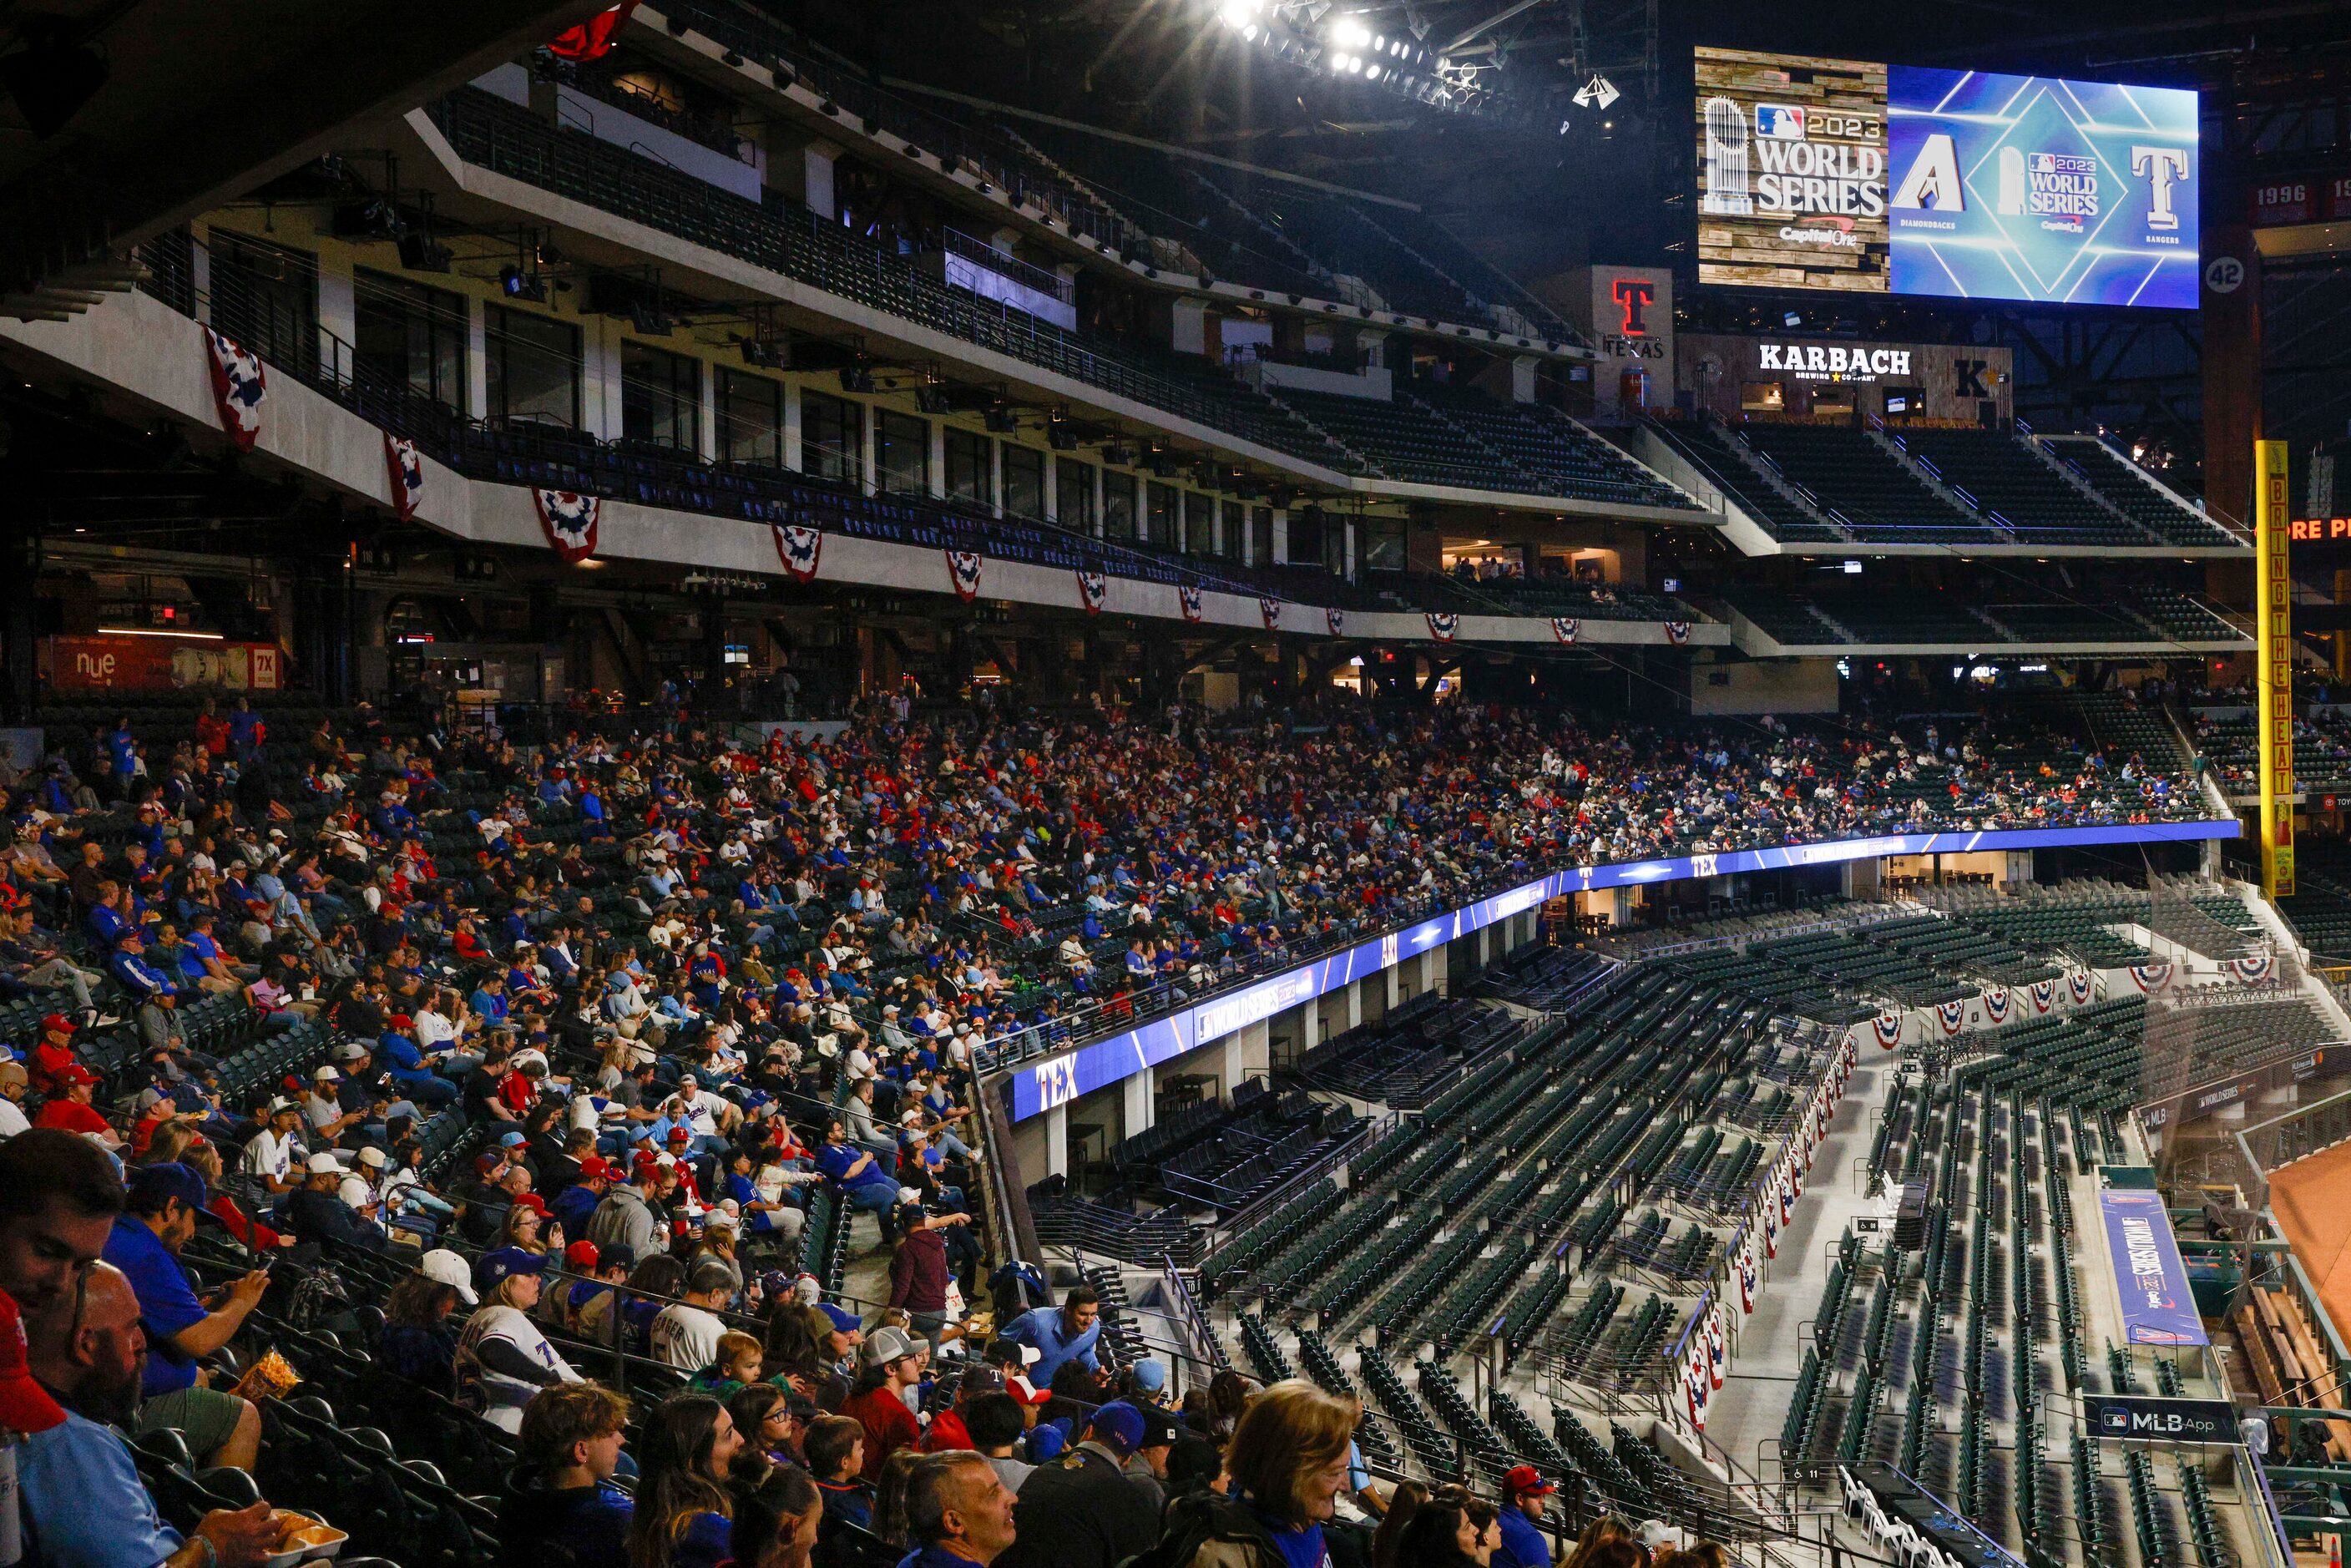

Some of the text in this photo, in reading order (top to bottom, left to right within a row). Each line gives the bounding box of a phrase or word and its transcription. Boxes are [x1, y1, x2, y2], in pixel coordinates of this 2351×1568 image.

[1807, 115, 1880, 139] 2023
[1755, 139, 1883, 180] WORLD
[2056, 158, 2096, 172] 2023
[2029, 173, 2098, 195] WORLD
[1757, 174, 1884, 217] SERIES
[2030, 192, 2099, 217] SERIES
[2257, 185, 2306, 205] 1996
[1900, 219, 1955, 230] DIAMONDBACKS
[2146, 235, 2180, 245] RANGERS
[2209, 264, 2239, 285] 42
[1605, 340, 1664, 359] TEXAS
[1759, 344, 1911, 375] KARBACH
[1795, 372, 1829, 381] BREWING
[1954, 359, 1989, 397] K
[1691, 854, 1717, 878] TEX
[1381, 933, 1398, 969] ARI
[1035, 1051, 1079, 1112] TEX
[2205, 1092, 2222, 1106] WORLD
[2221, 1085, 2238, 1101] SERIES
[2151, 1107, 2166, 1127] MLB
[2123, 1226, 2156, 1252] WORLD
[2127, 1249, 2164, 1276] SERIES
[1186, 1282, 1196, 1292] 10
[2132, 1413, 2215, 1434] MLB App
[1809, 1469, 1818, 1478] 11
